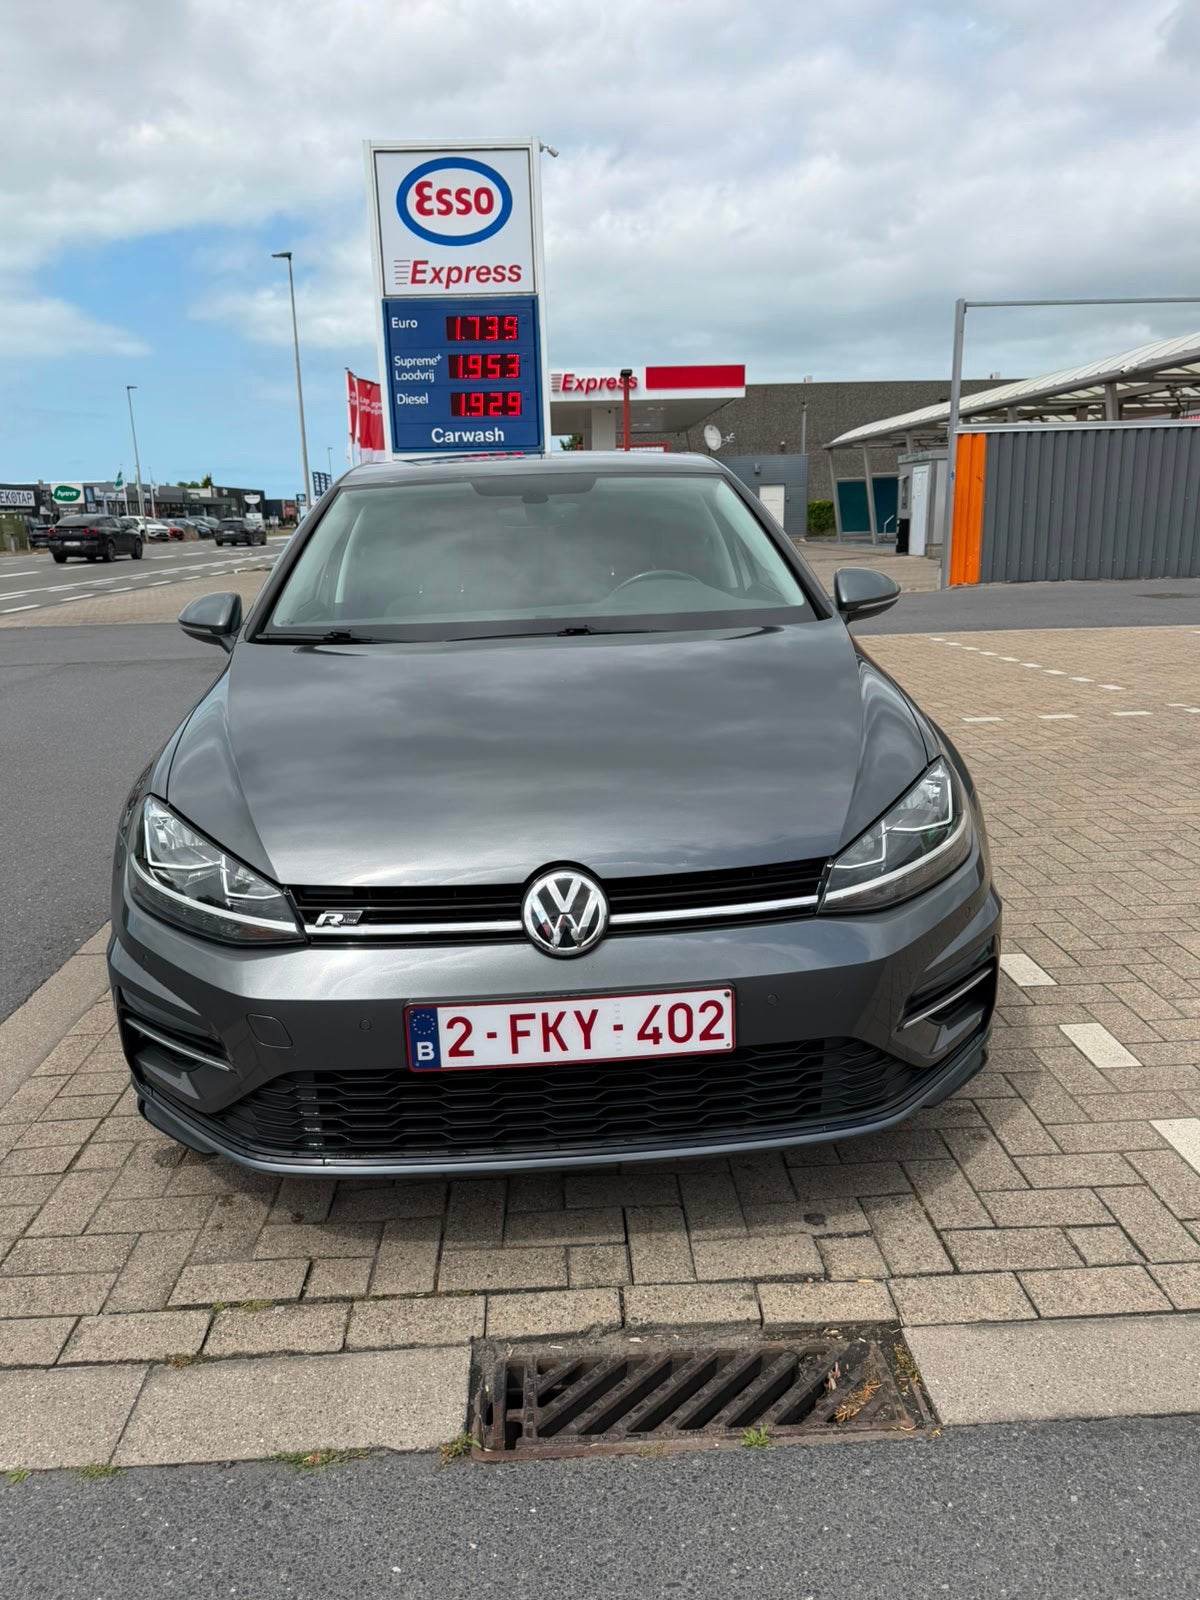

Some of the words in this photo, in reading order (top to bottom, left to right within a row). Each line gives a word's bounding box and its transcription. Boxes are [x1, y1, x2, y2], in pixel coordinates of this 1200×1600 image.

[415, 180, 494, 216] Esso
[410, 259, 522, 289] Express
[391, 317, 418, 329] Euro
[395, 370, 435, 383] Loodvrij
[561, 374, 638, 395] Express
[397, 393, 429, 405] Diesel
[431, 427, 505, 443] Carwash
[417, 1041, 435, 1061] B
